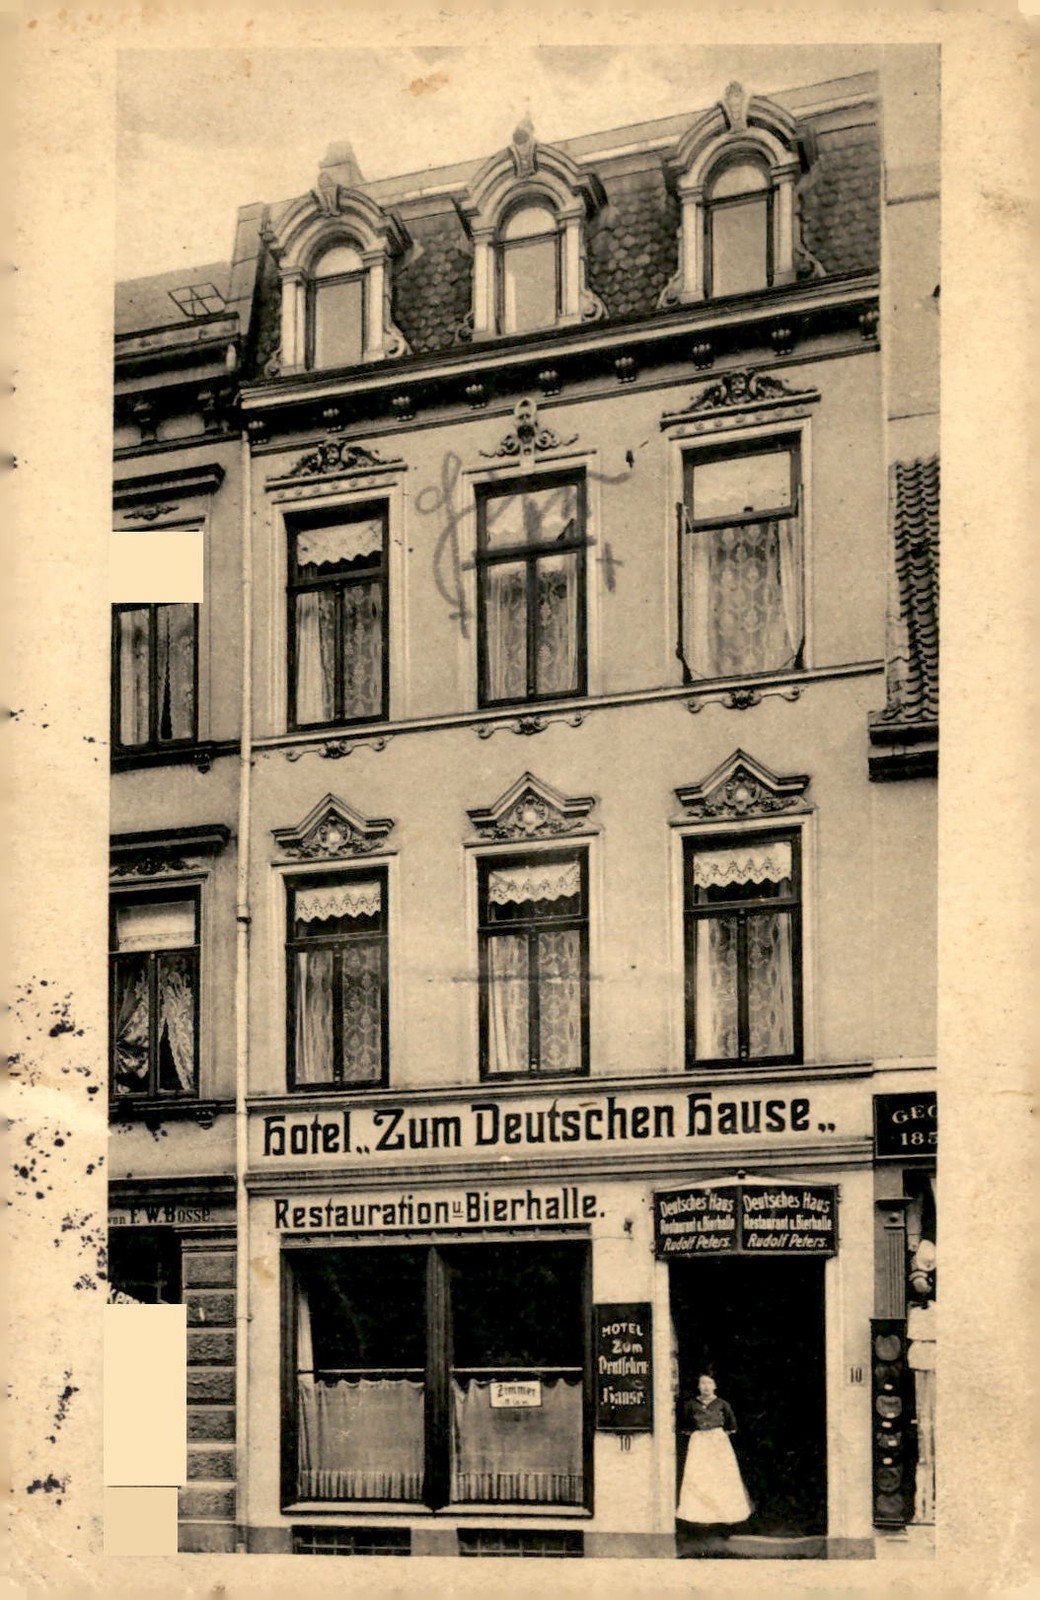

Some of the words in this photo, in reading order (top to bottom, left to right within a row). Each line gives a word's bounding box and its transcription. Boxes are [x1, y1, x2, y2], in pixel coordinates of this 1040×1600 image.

[263, 1110, 351, 1157] Hotel
[471, 1096, 675, 1148] Deutschen
[274, 1194, 450, 1229] Restauration
[466, 1187, 605, 1223] Bierhalle.
[660, 1194, 707, 1218] Deutsches
[709, 1193, 735, 1213] Haus
[743, 1190, 801, 1213] Deutsches
[802, 1191, 831, 1214] Haus
[663, 1235, 697, 1251] Rudolf
[747, 1233, 789, 1248] Rudolf
